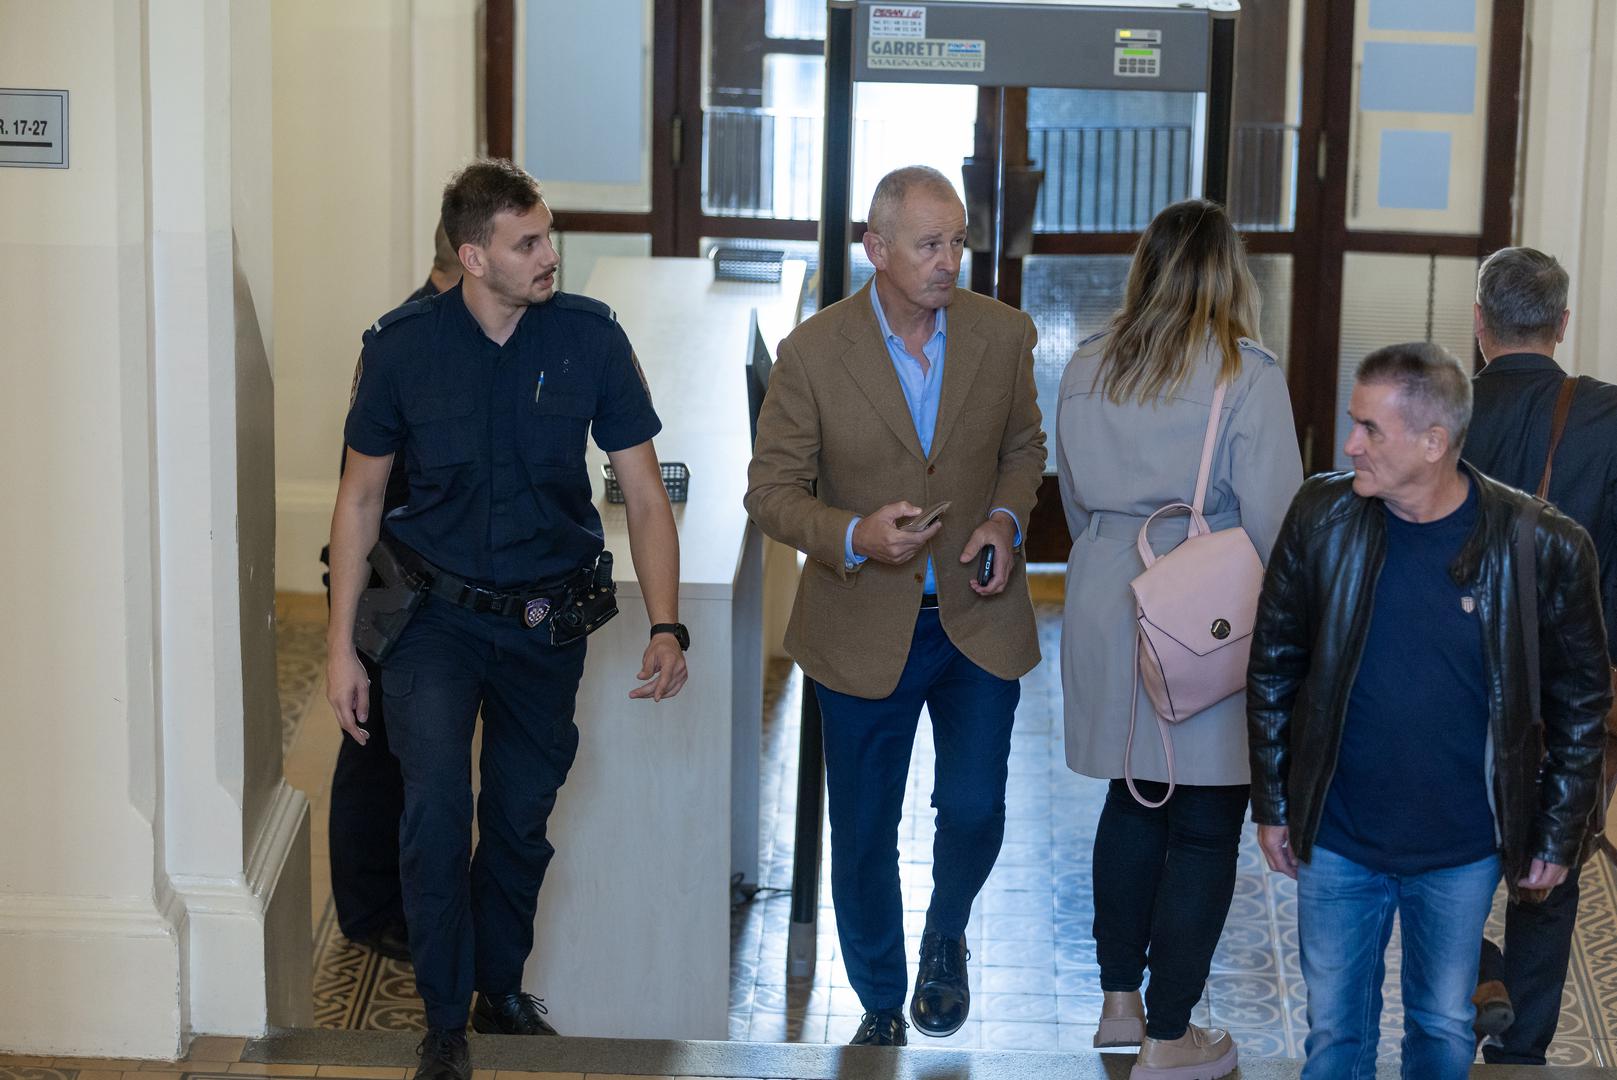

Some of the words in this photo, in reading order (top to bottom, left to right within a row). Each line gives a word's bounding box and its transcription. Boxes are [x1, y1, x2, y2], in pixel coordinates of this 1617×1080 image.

[871, 40, 946, 56] GARRETT
[871, 58, 982, 68] MAGNASCANNER
[13, 119, 48, 136] 17-27
